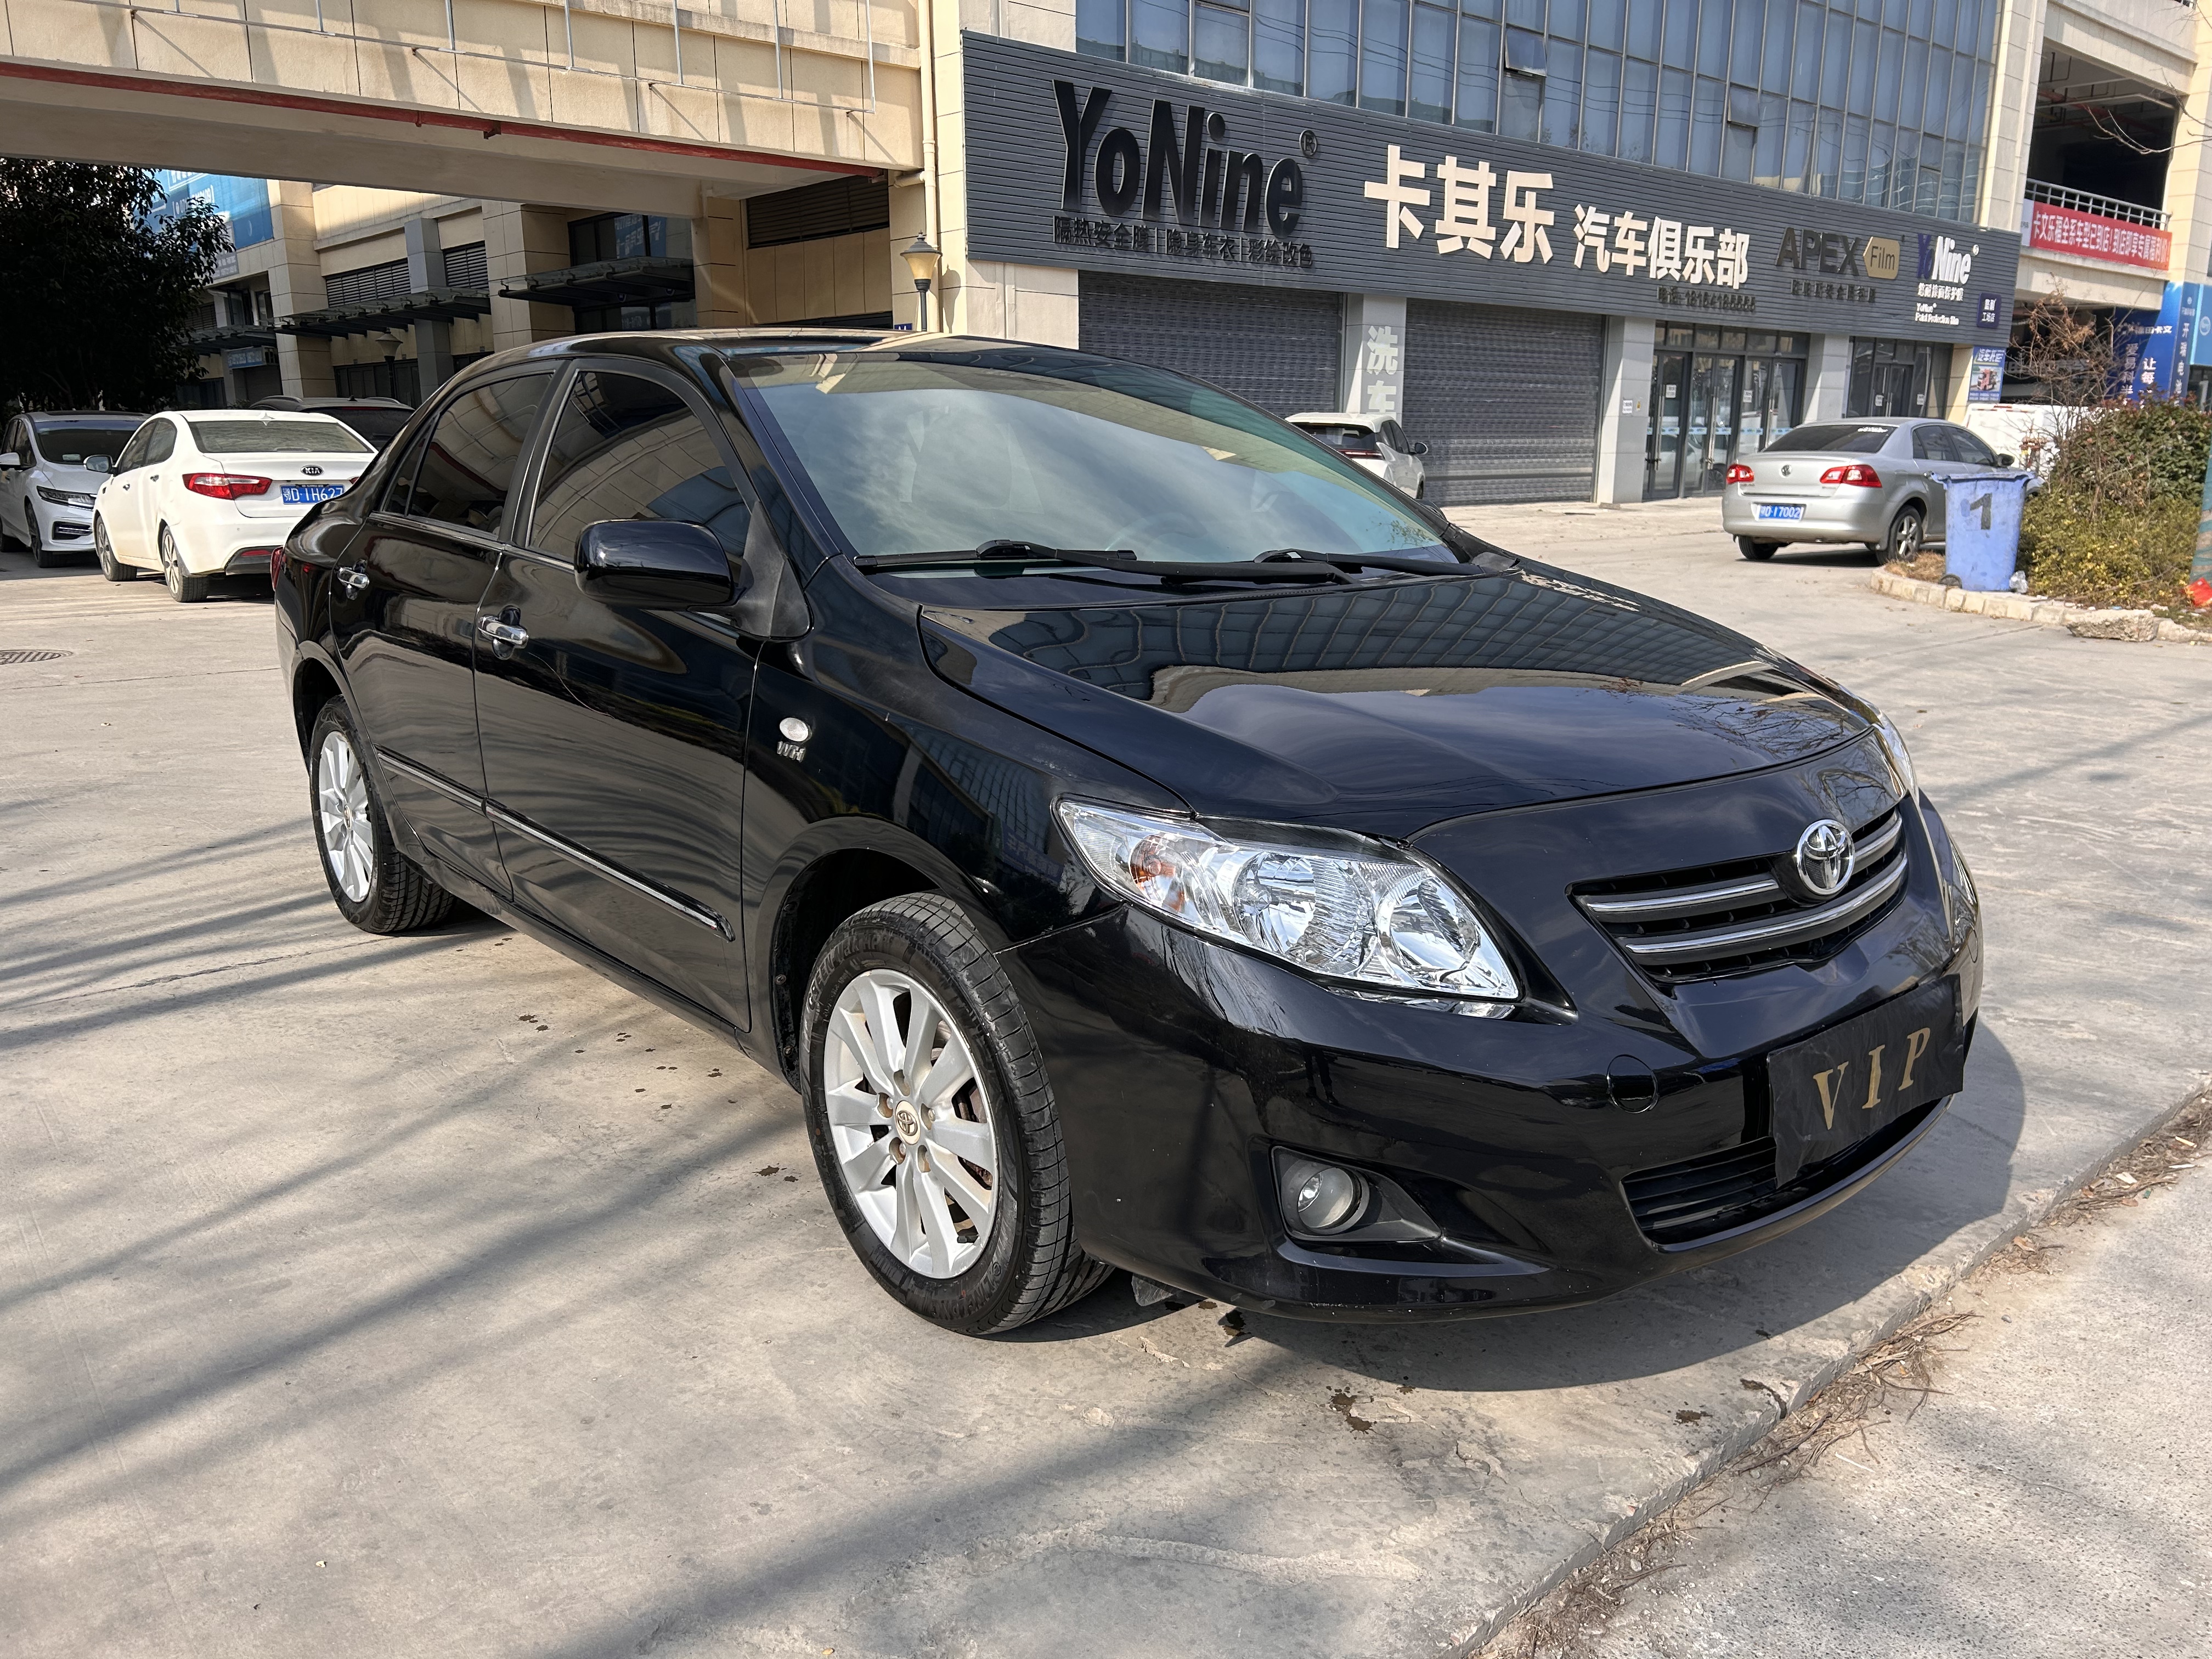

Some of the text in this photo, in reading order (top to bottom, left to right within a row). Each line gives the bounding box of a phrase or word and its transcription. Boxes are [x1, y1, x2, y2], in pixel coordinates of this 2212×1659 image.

[1052, 79, 1302, 239] YoNine
[1364, 144, 1750, 290] 卡其乐 汽车俱乐部
[1775, 227, 1896, 276] APEX Film
[1917, 233, 1972, 285] YoNine
[1970, 493, 1993, 530] 1
[1813, 1027, 1931, 1130] VIP
